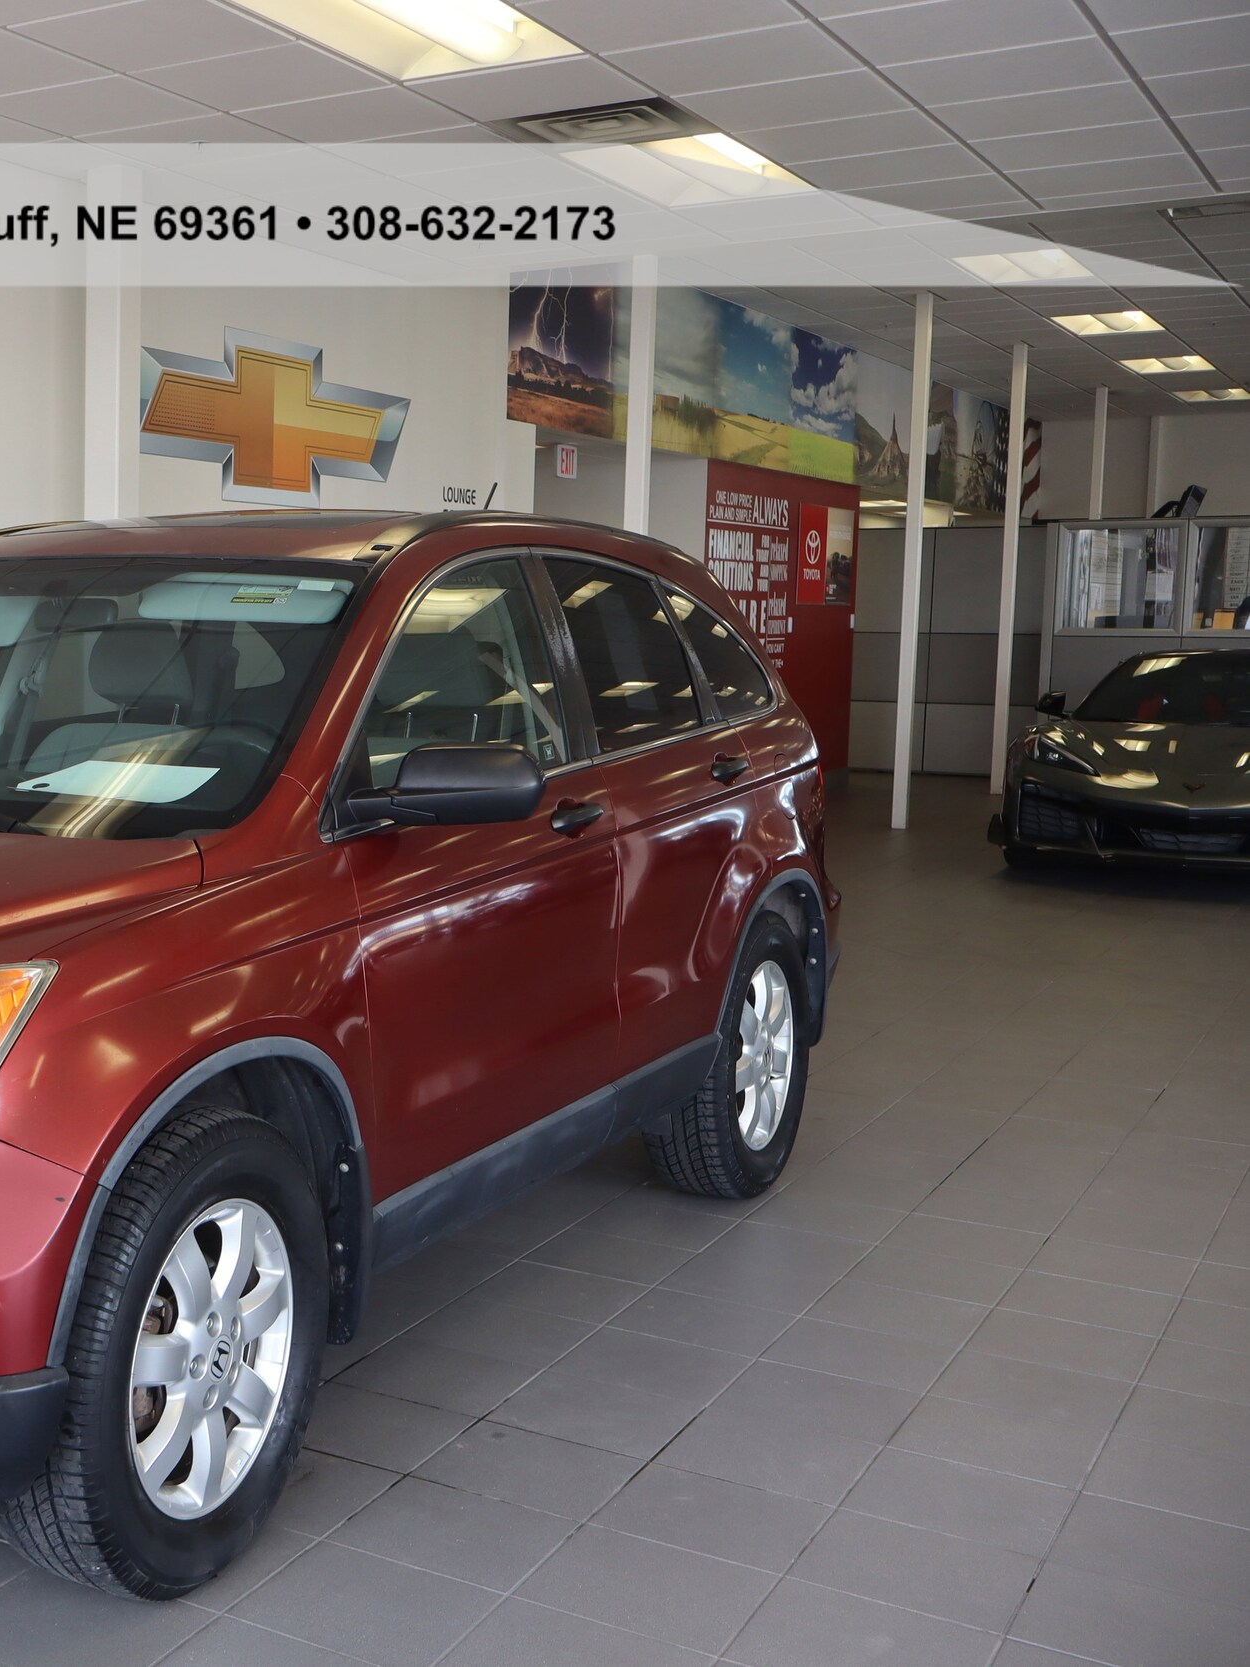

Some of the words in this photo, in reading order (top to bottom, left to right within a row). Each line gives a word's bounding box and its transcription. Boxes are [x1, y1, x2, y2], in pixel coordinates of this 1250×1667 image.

[560, 447, 575, 475] EXIT
[442, 485, 477, 505] LOUNGE
[716, 490, 726, 504] ONE
[727, 491, 738, 506] LOW
[739, 493, 752, 508] PRICE
[710, 505, 724, 519] PLAIN
[724, 506, 735, 521] AND
[736, 508, 752, 523] SIMPLE
[753, 495, 789, 527] ALWAYS
[708, 528, 754, 562] FINANCIAL
[803, 568, 821, 580] TOYOTA
